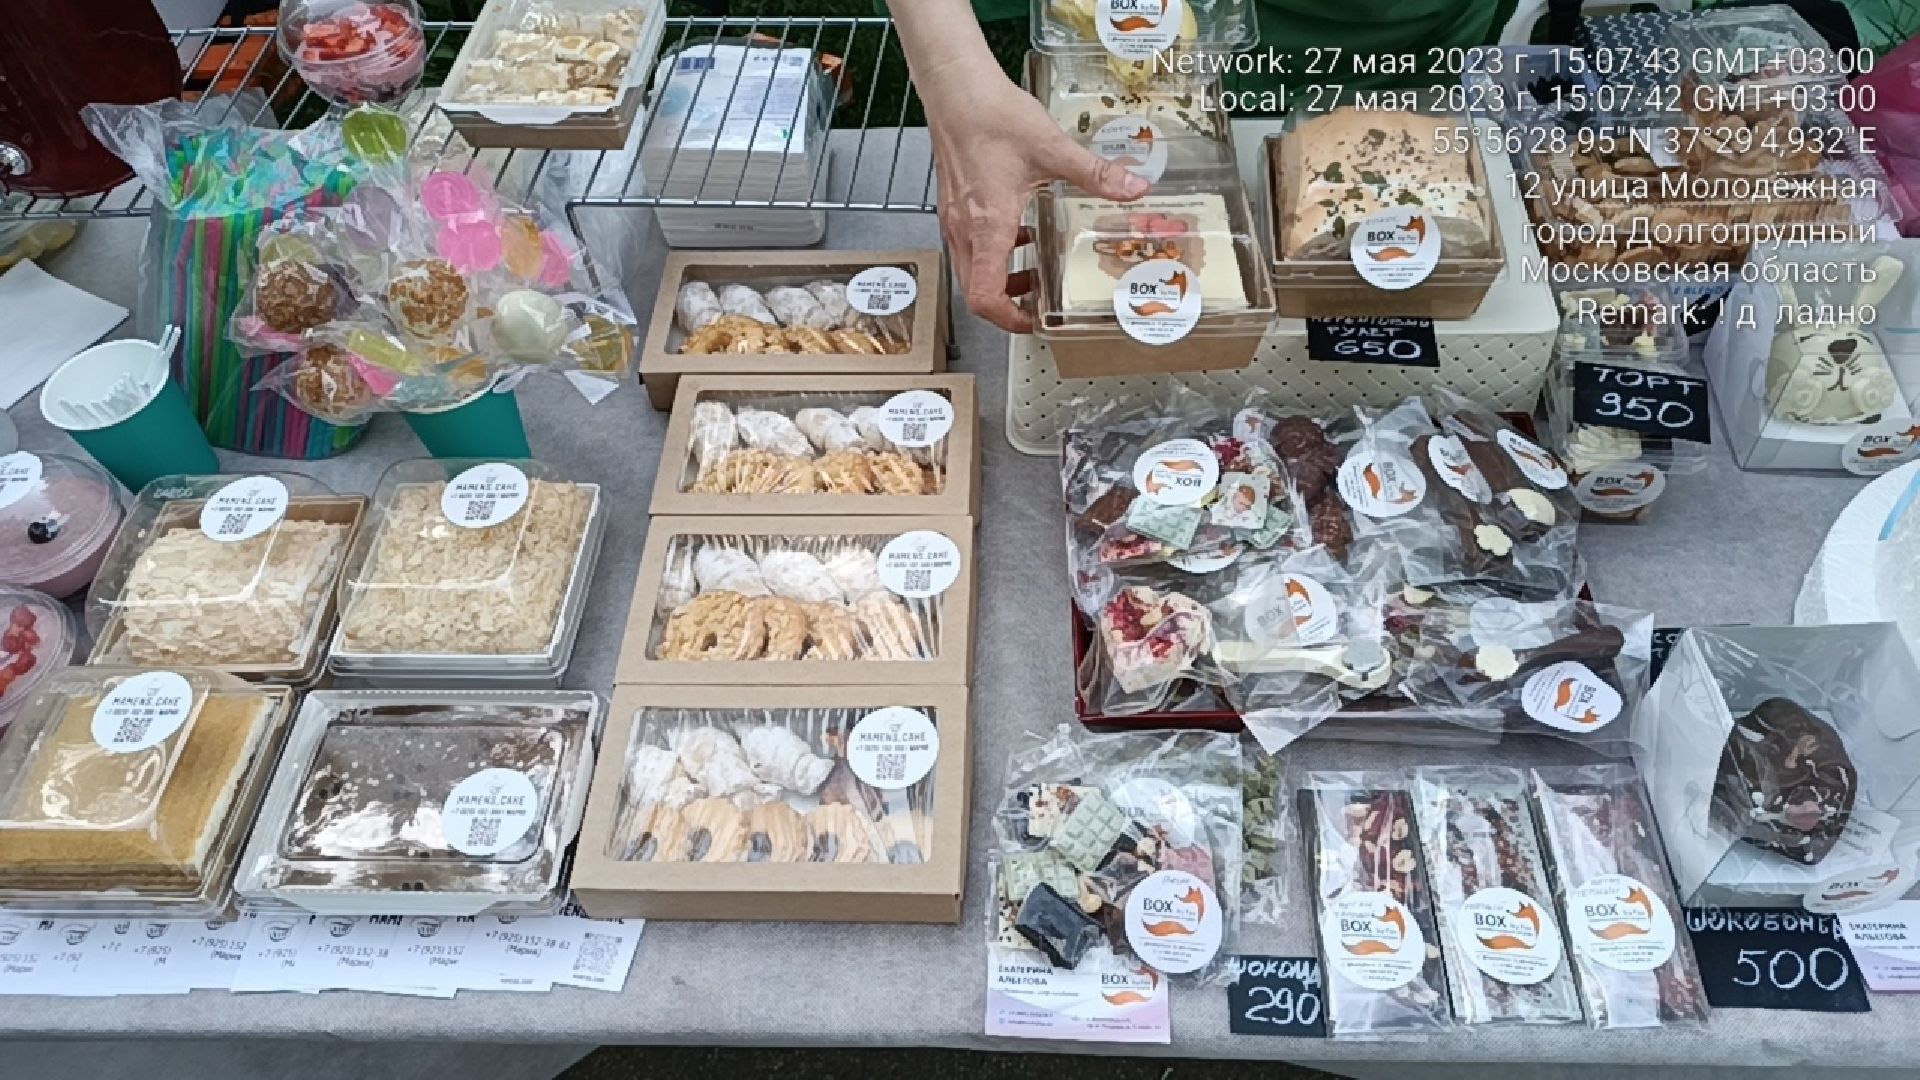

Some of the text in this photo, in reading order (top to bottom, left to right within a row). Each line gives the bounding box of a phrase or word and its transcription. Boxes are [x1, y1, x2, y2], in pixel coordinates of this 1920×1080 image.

[1367, 231, 1396, 242] BOX
[1130, 282, 1157, 295] BOX
[1334, 340, 1421, 359] 650
[1593, 367, 1704, 396] ТОРТ
[1595, 392, 1694, 428] 950
[1143, 898, 1174, 914] BOX
[1584, 903, 1618, 917] BOX
[1341, 920, 1372, 933] BOX
[1473, 912, 1507, 928] BOX
[1732, 947, 1849, 991] 500
[1101, 974, 1129, 985] BOX
[1245, 986, 1321, 1025] 290
